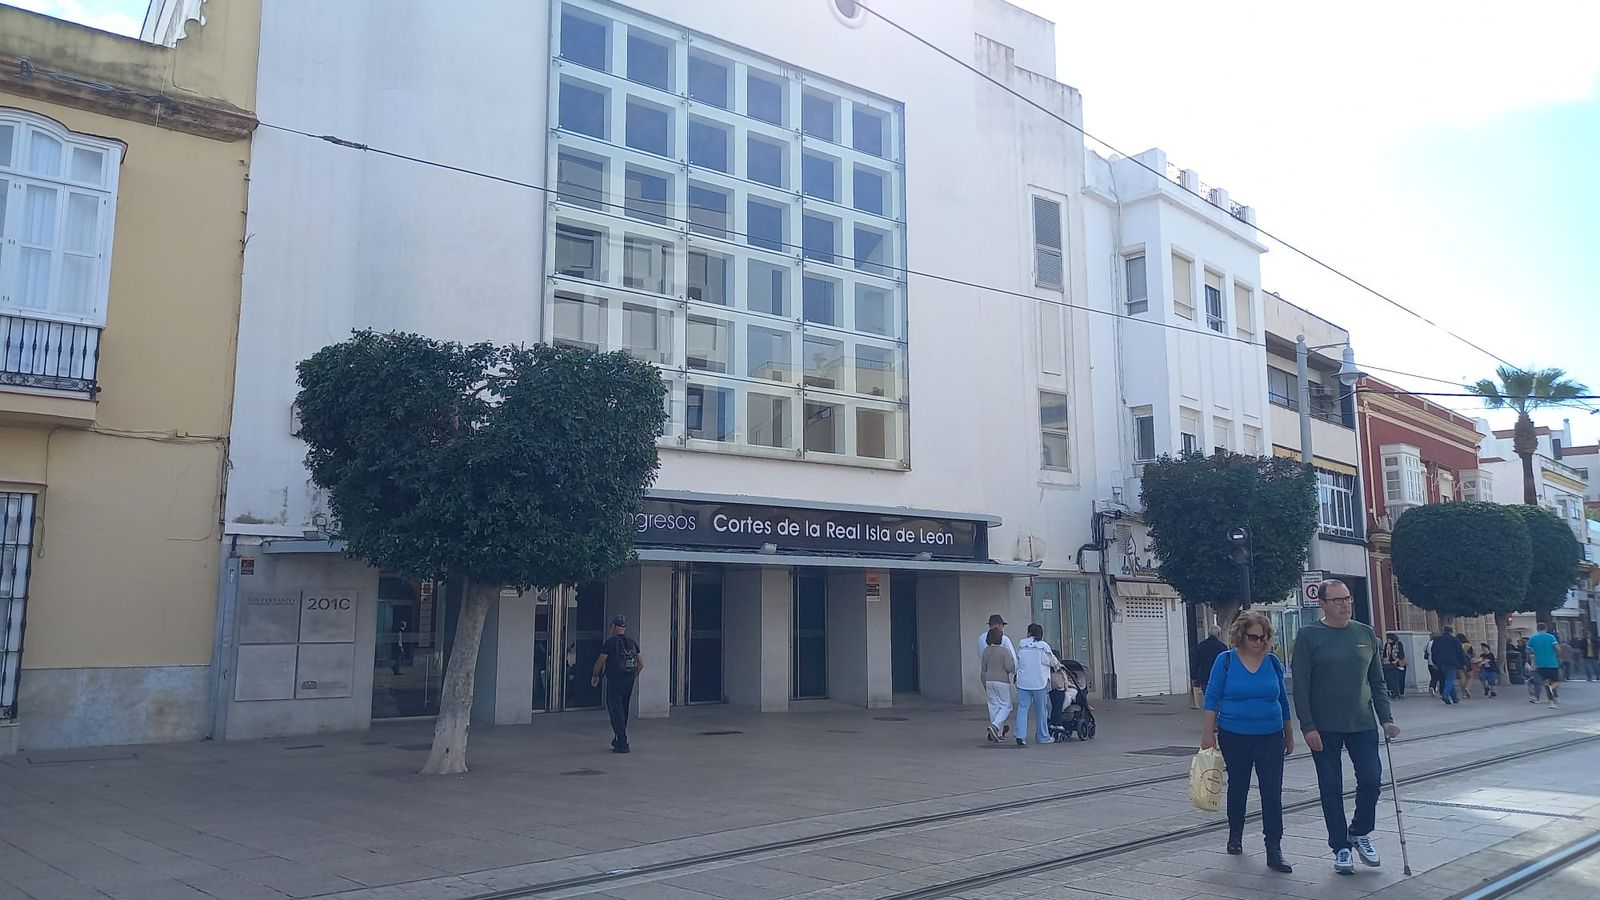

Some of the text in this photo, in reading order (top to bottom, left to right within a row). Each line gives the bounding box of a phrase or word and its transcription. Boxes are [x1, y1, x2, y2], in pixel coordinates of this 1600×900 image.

[713, 513, 772, 535] Cortes
[777, 518, 800, 537] de
[805, 519, 821, 538] la
[826, 521, 861, 540] Real
[865, 522, 891, 542] Isla
[895, 525, 915, 543] de
[920, 527, 954, 545] León
